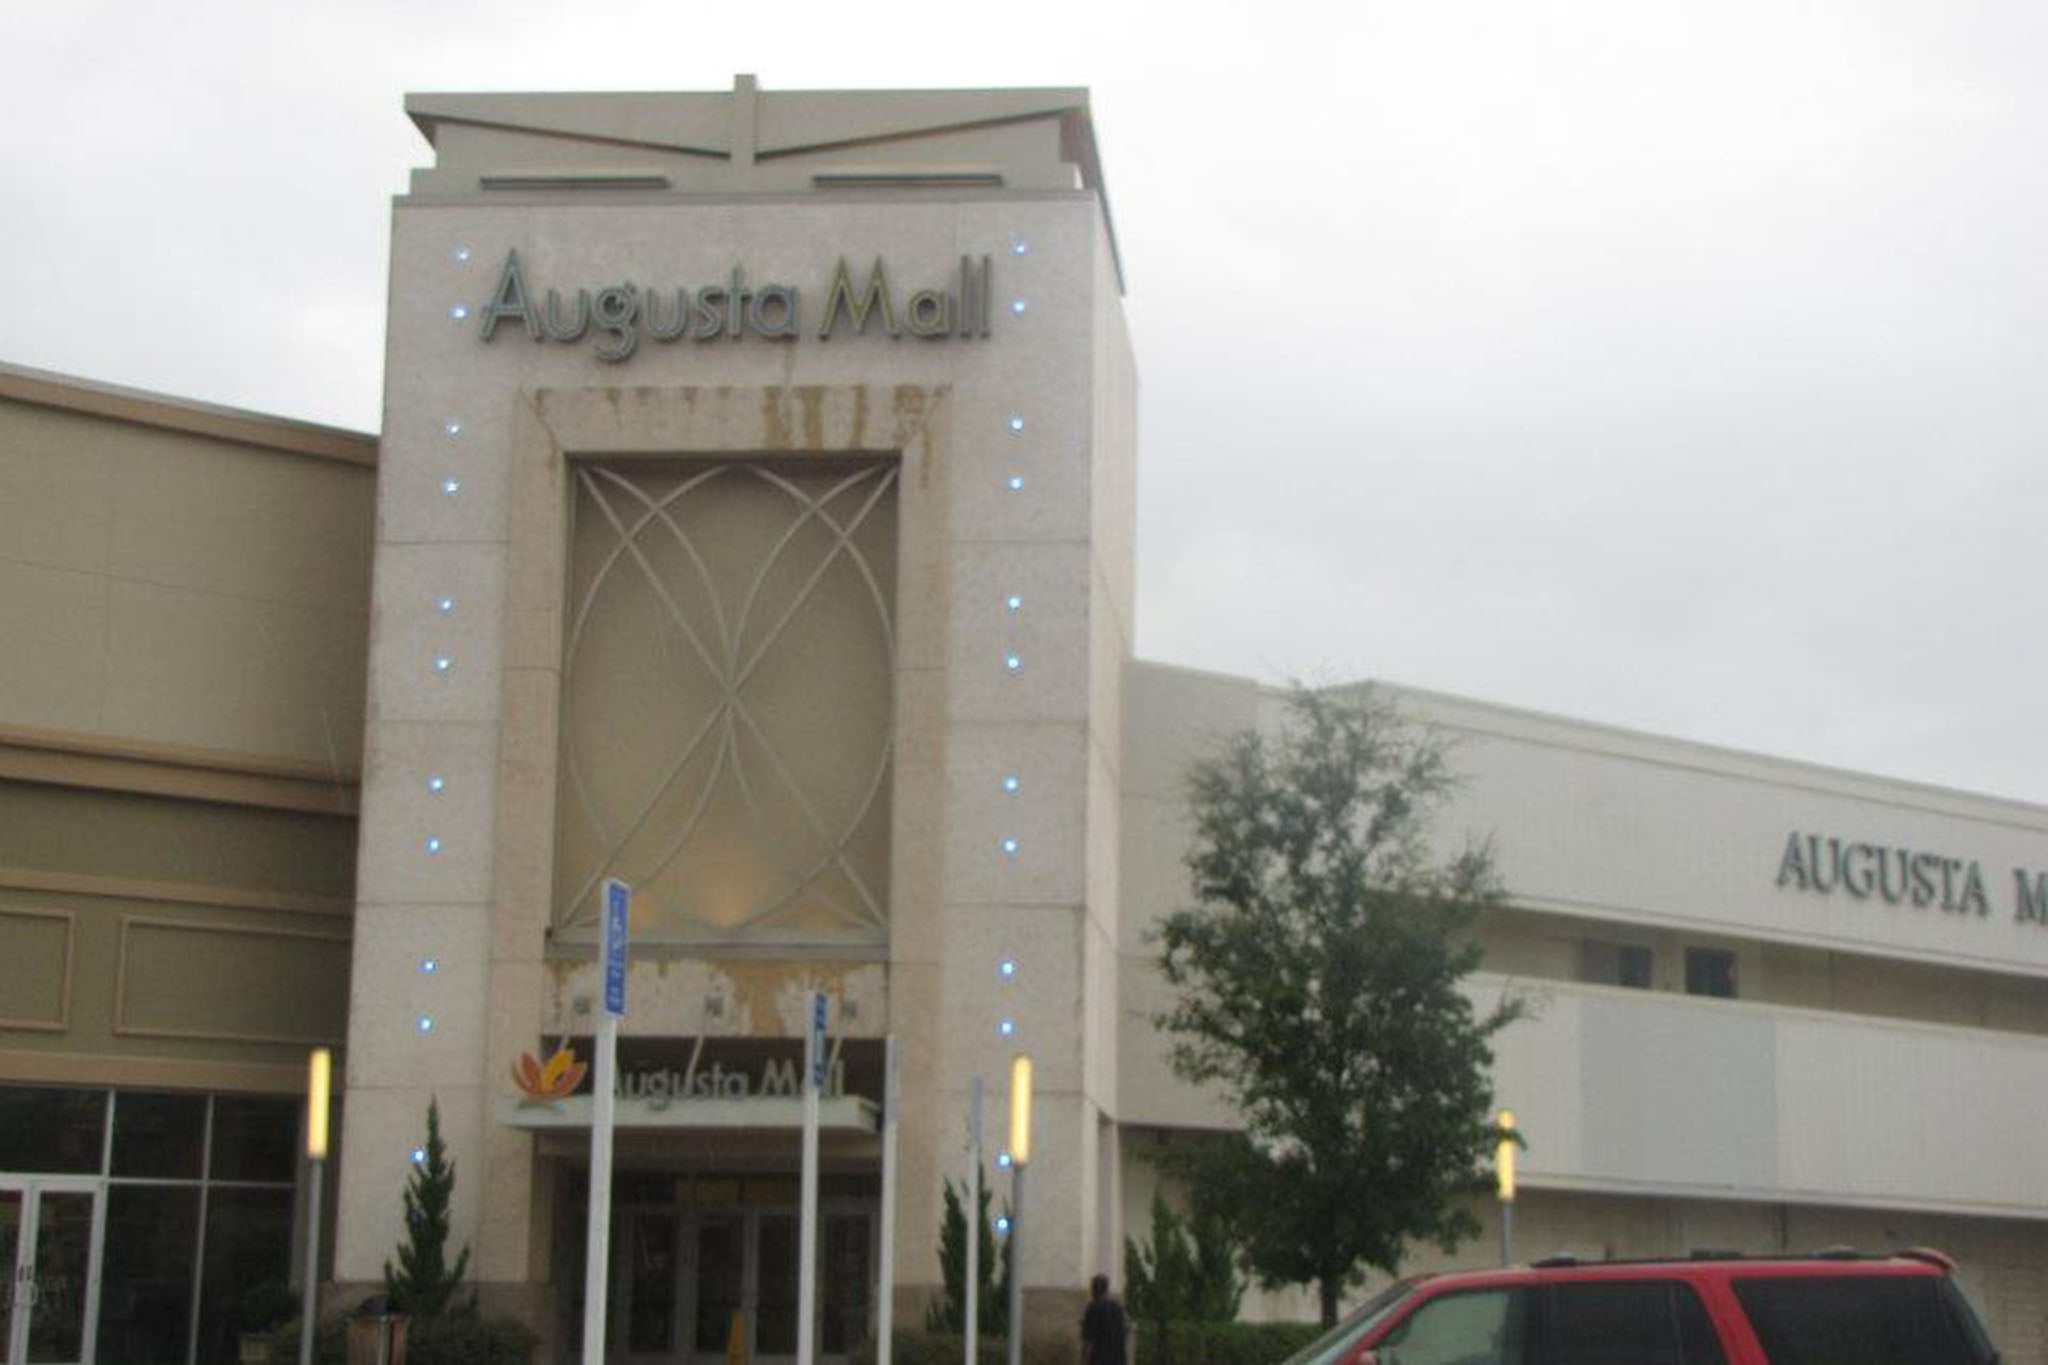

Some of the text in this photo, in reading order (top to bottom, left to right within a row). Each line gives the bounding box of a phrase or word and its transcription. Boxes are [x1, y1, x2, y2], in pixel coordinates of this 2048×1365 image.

[480, 248, 993, 363] Augusta Mall
[1775, 831, 1990, 917] AUGUSTA
